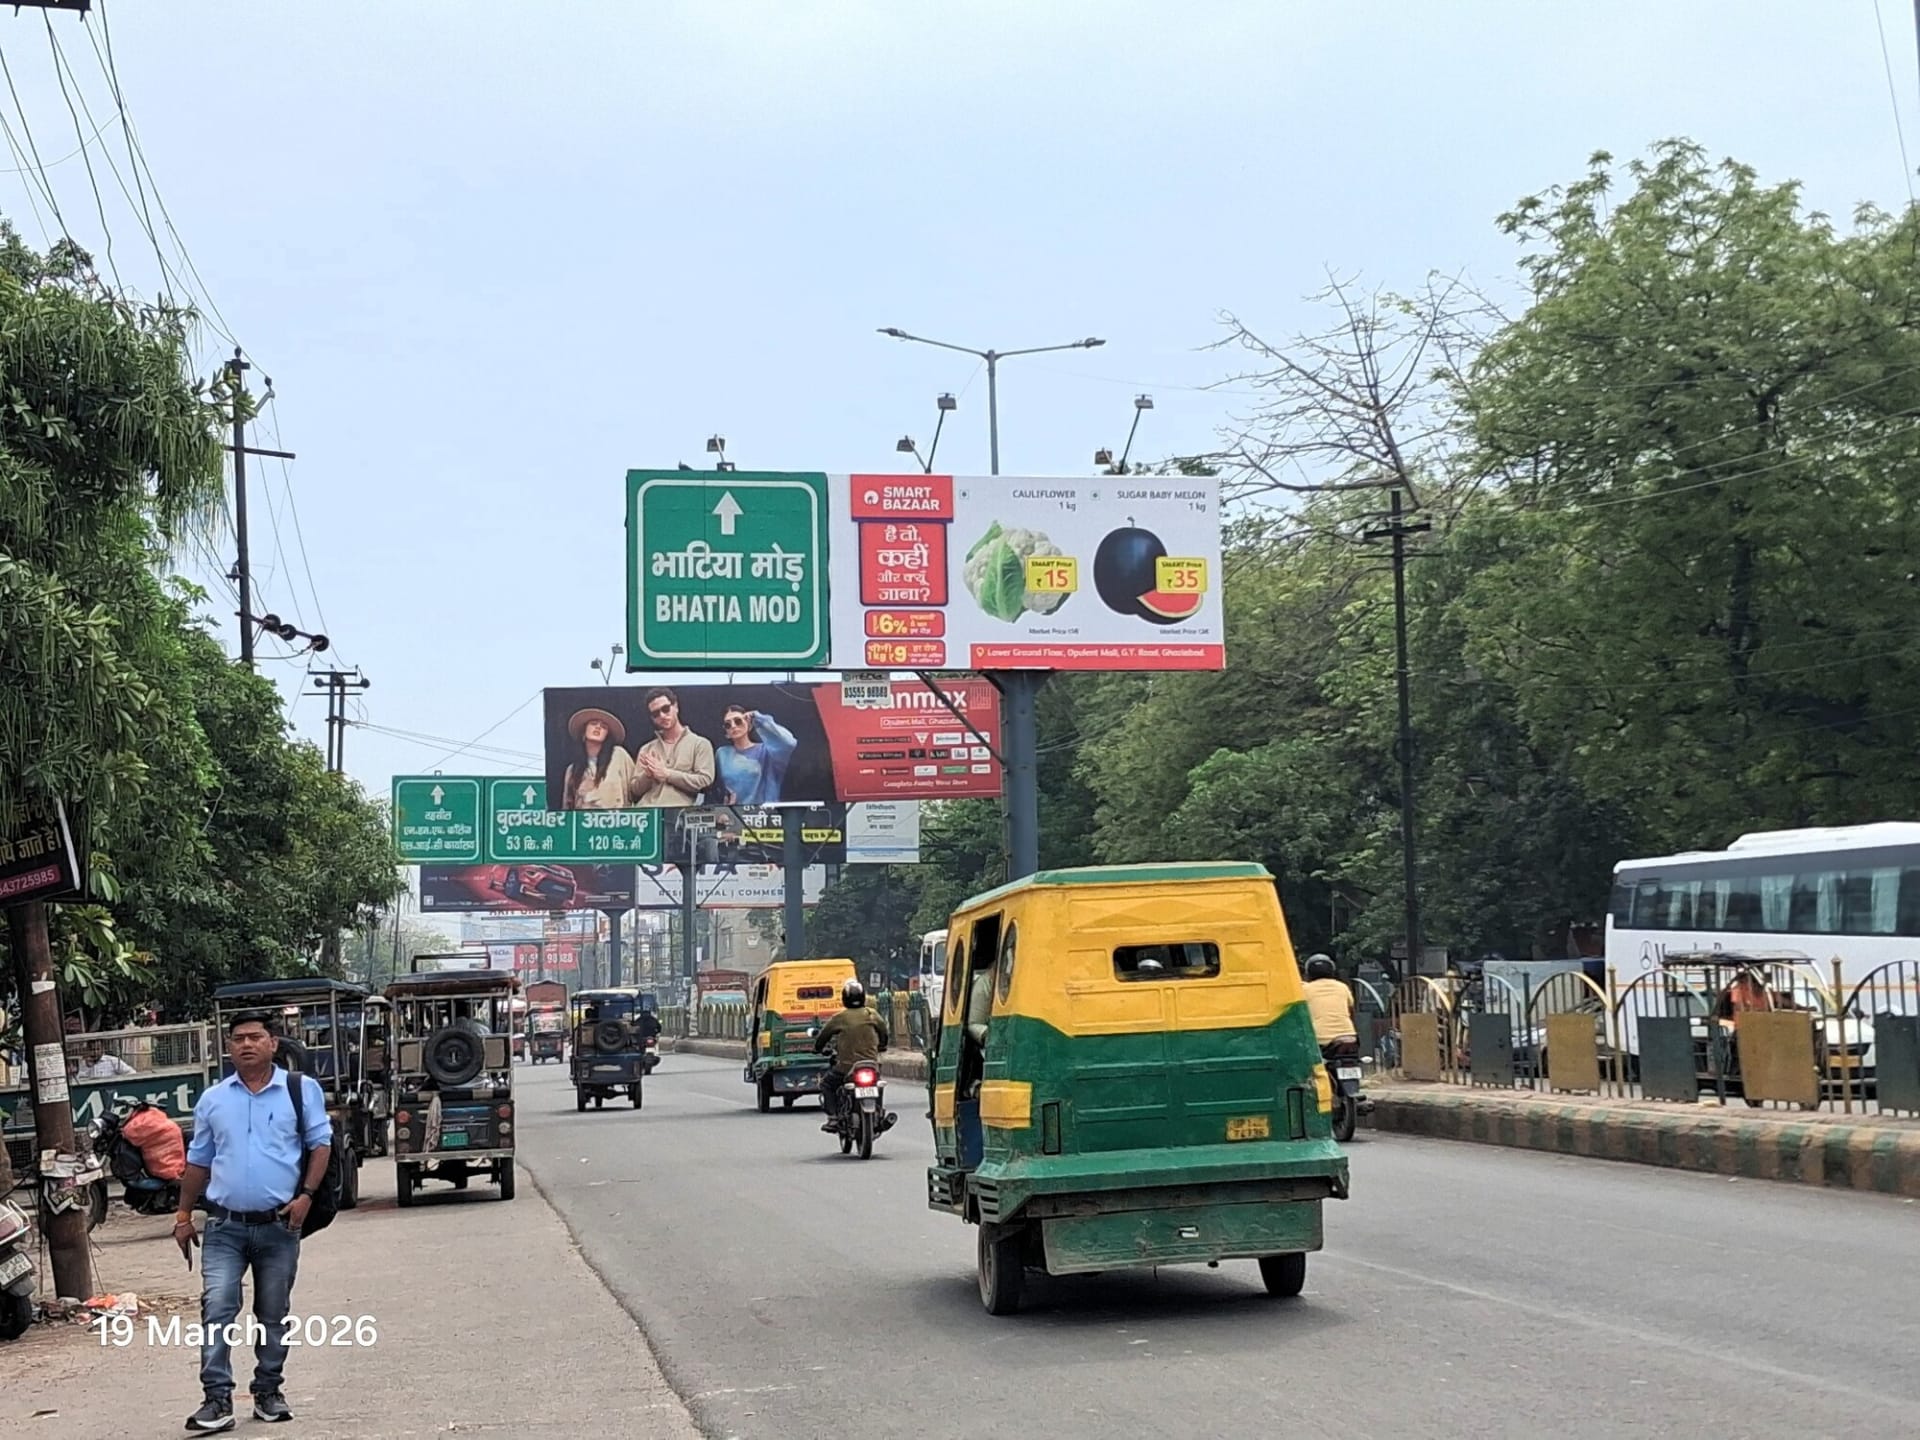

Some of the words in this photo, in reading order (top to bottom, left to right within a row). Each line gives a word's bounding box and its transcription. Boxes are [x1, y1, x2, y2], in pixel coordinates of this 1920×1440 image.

[883, 487, 932, 498] SMART
[1013, 490, 1076, 499] CAULIFLOWER
[1118, 491, 1148, 500] SUGAR
[1150, 491, 1172, 500] BABY
[1174, 491, 1206, 500] MELON
[883, 499, 941, 511] BAZAAR
[1065, 502, 1076, 512] kg
[1195, 503, 1206, 513] kg
[884, 524, 897, 542] है
[876, 543, 929, 569] कहीं
[652, 540, 744, 579] भाटिया
[750, 542, 806, 592] मोड़
[1056, 561, 1072, 569] Price
[878, 570, 899, 583] और
[878, 587, 931, 601] जाना?
[656, 594, 742, 622] BHATIA
[750, 595, 800, 623] MOD
[988, 648, 1009, 657] Lower
[1012, 648, 1040, 657] Ground
[1067, 648, 1099, 659] Opulent
[16, 830, 45, 859] जाते
[505, 835, 521, 850] 53
[588, 834, 609, 850] 120
